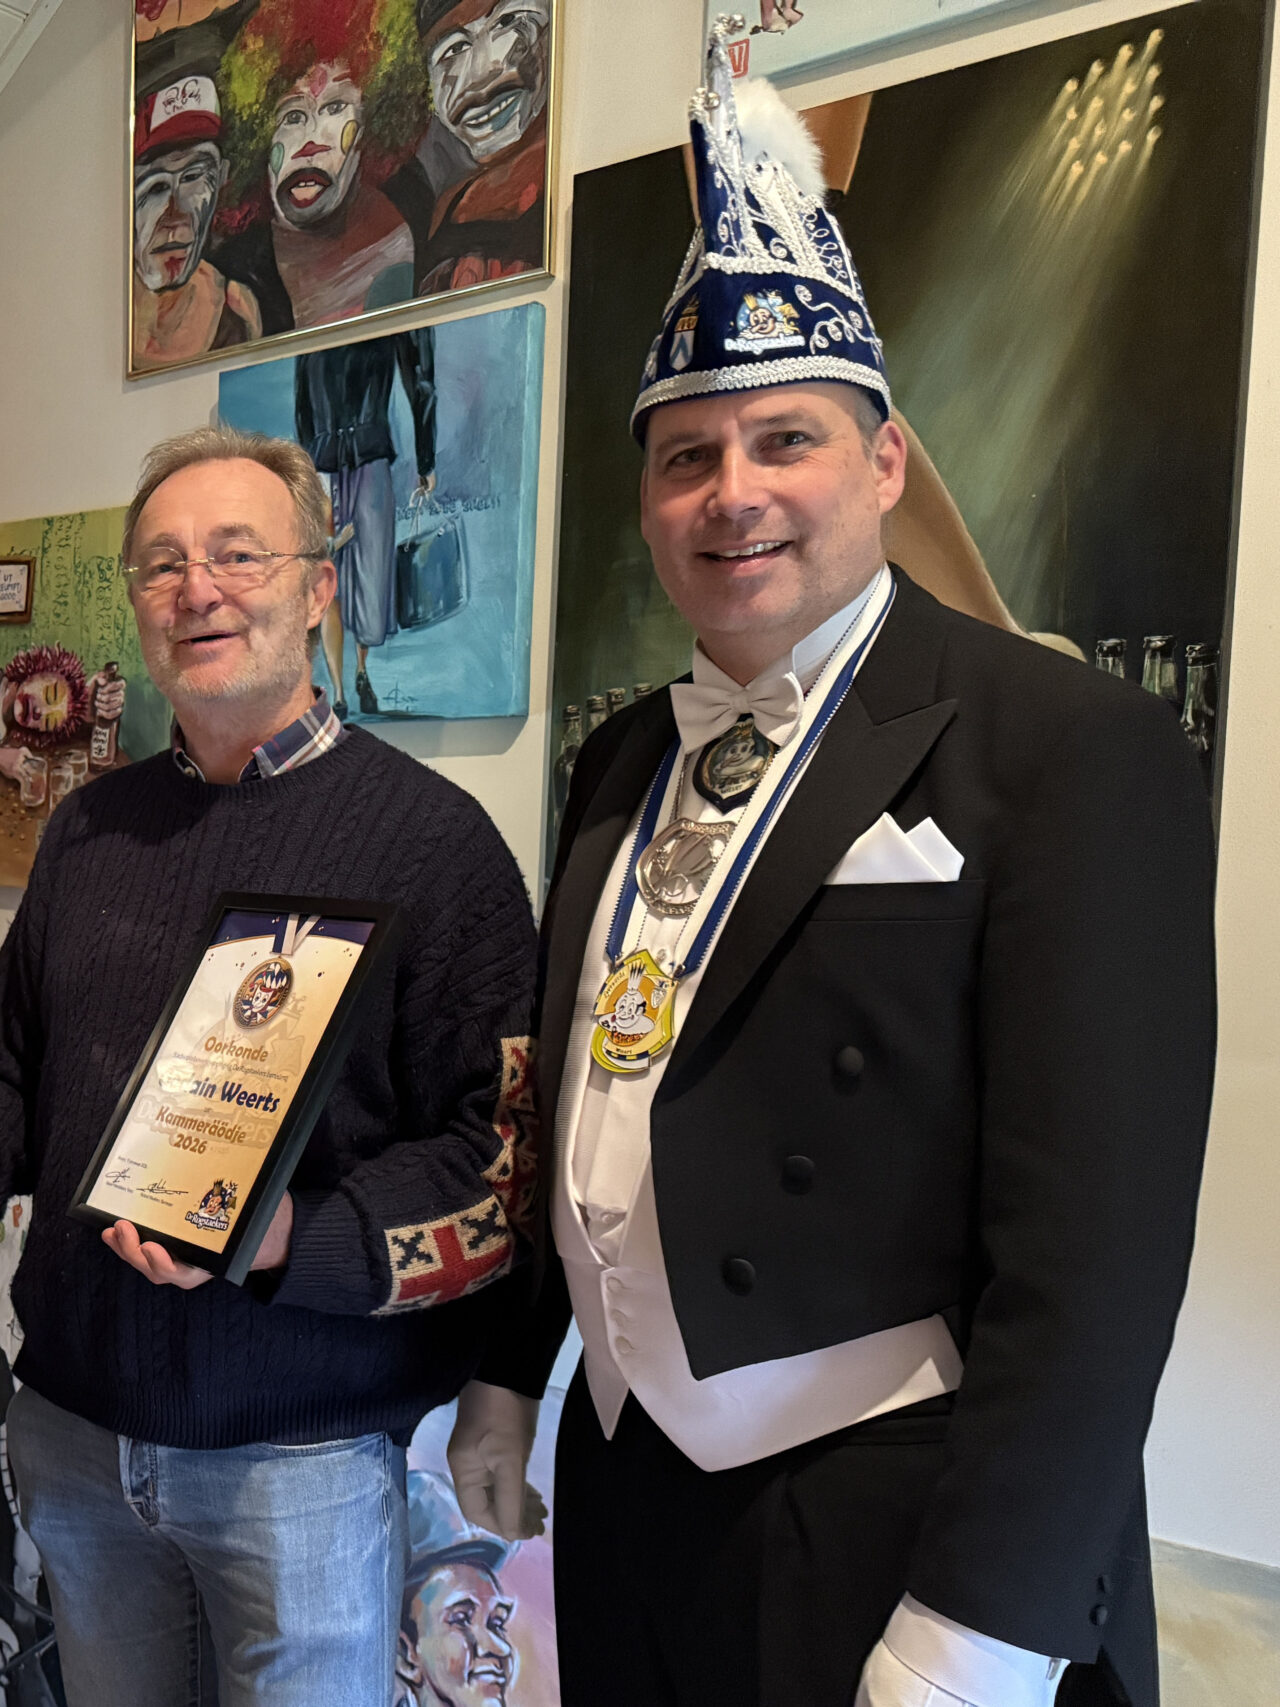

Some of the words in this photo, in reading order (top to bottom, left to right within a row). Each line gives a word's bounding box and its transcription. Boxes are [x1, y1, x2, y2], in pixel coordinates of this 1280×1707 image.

[204, 1035, 269, 1063] Oorkonde
[220, 1080, 281, 1113] Weerts
[155, 1105, 247, 1144] Kammeräödje
[174, 1133, 208, 1155] 2026
